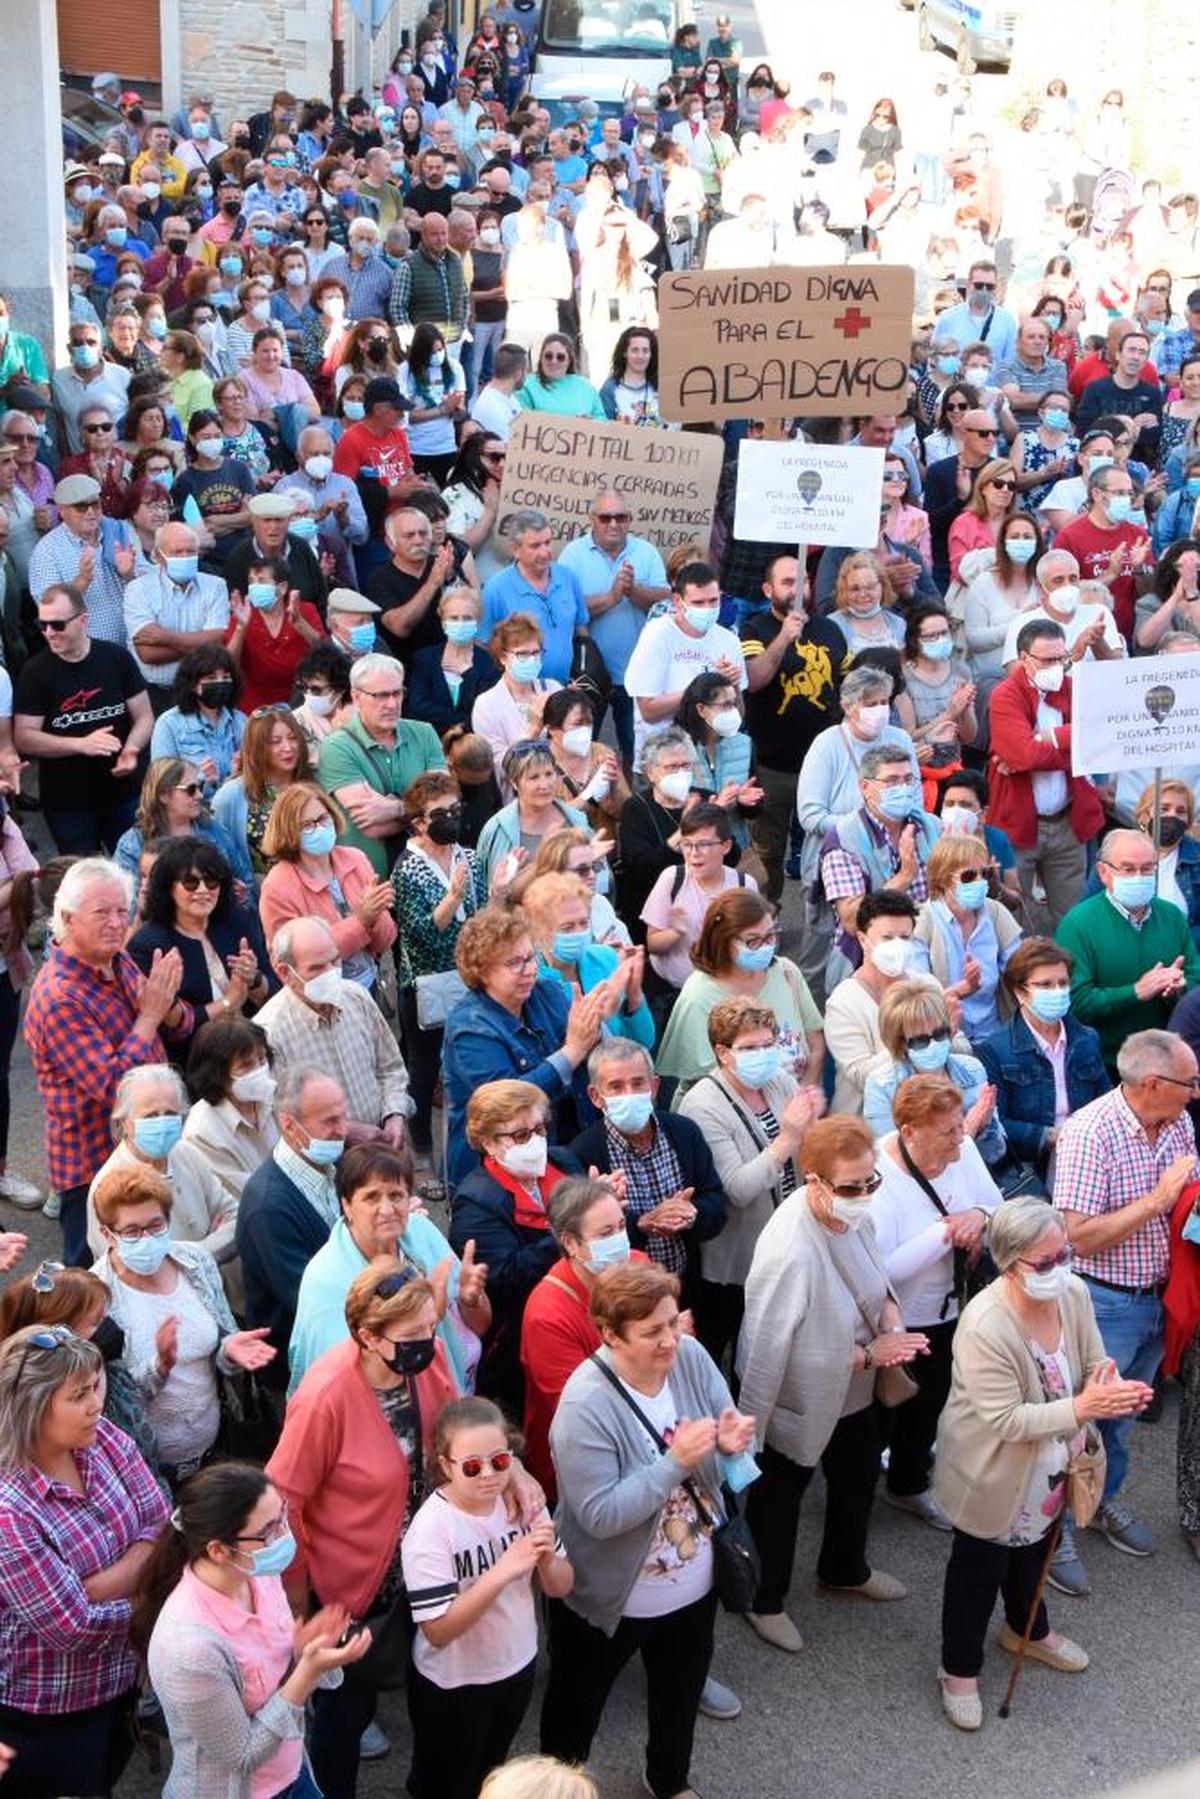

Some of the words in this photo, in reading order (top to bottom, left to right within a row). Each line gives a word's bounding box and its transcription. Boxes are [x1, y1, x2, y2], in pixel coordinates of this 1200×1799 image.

[669, 275, 792, 310] SANIDAD
[806, 275, 879, 302] DIGNA
[716, 319, 767, 344] PARA
[776, 320, 814, 339] EL
[679, 357, 908, 407] ABADENGO
[521, 424, 634, 461] HOSPITAL
[517, 462, 608, 490] URGENCIAS
[613, 474, 699, 499] CERRADAS
[638, 507, 659, 522] SIN
[663, 508, 712, 526] MEDICOS
[1123, 745, 1144, 756] DEL
[1145, 741, 1196, 753] HOSPITAL
